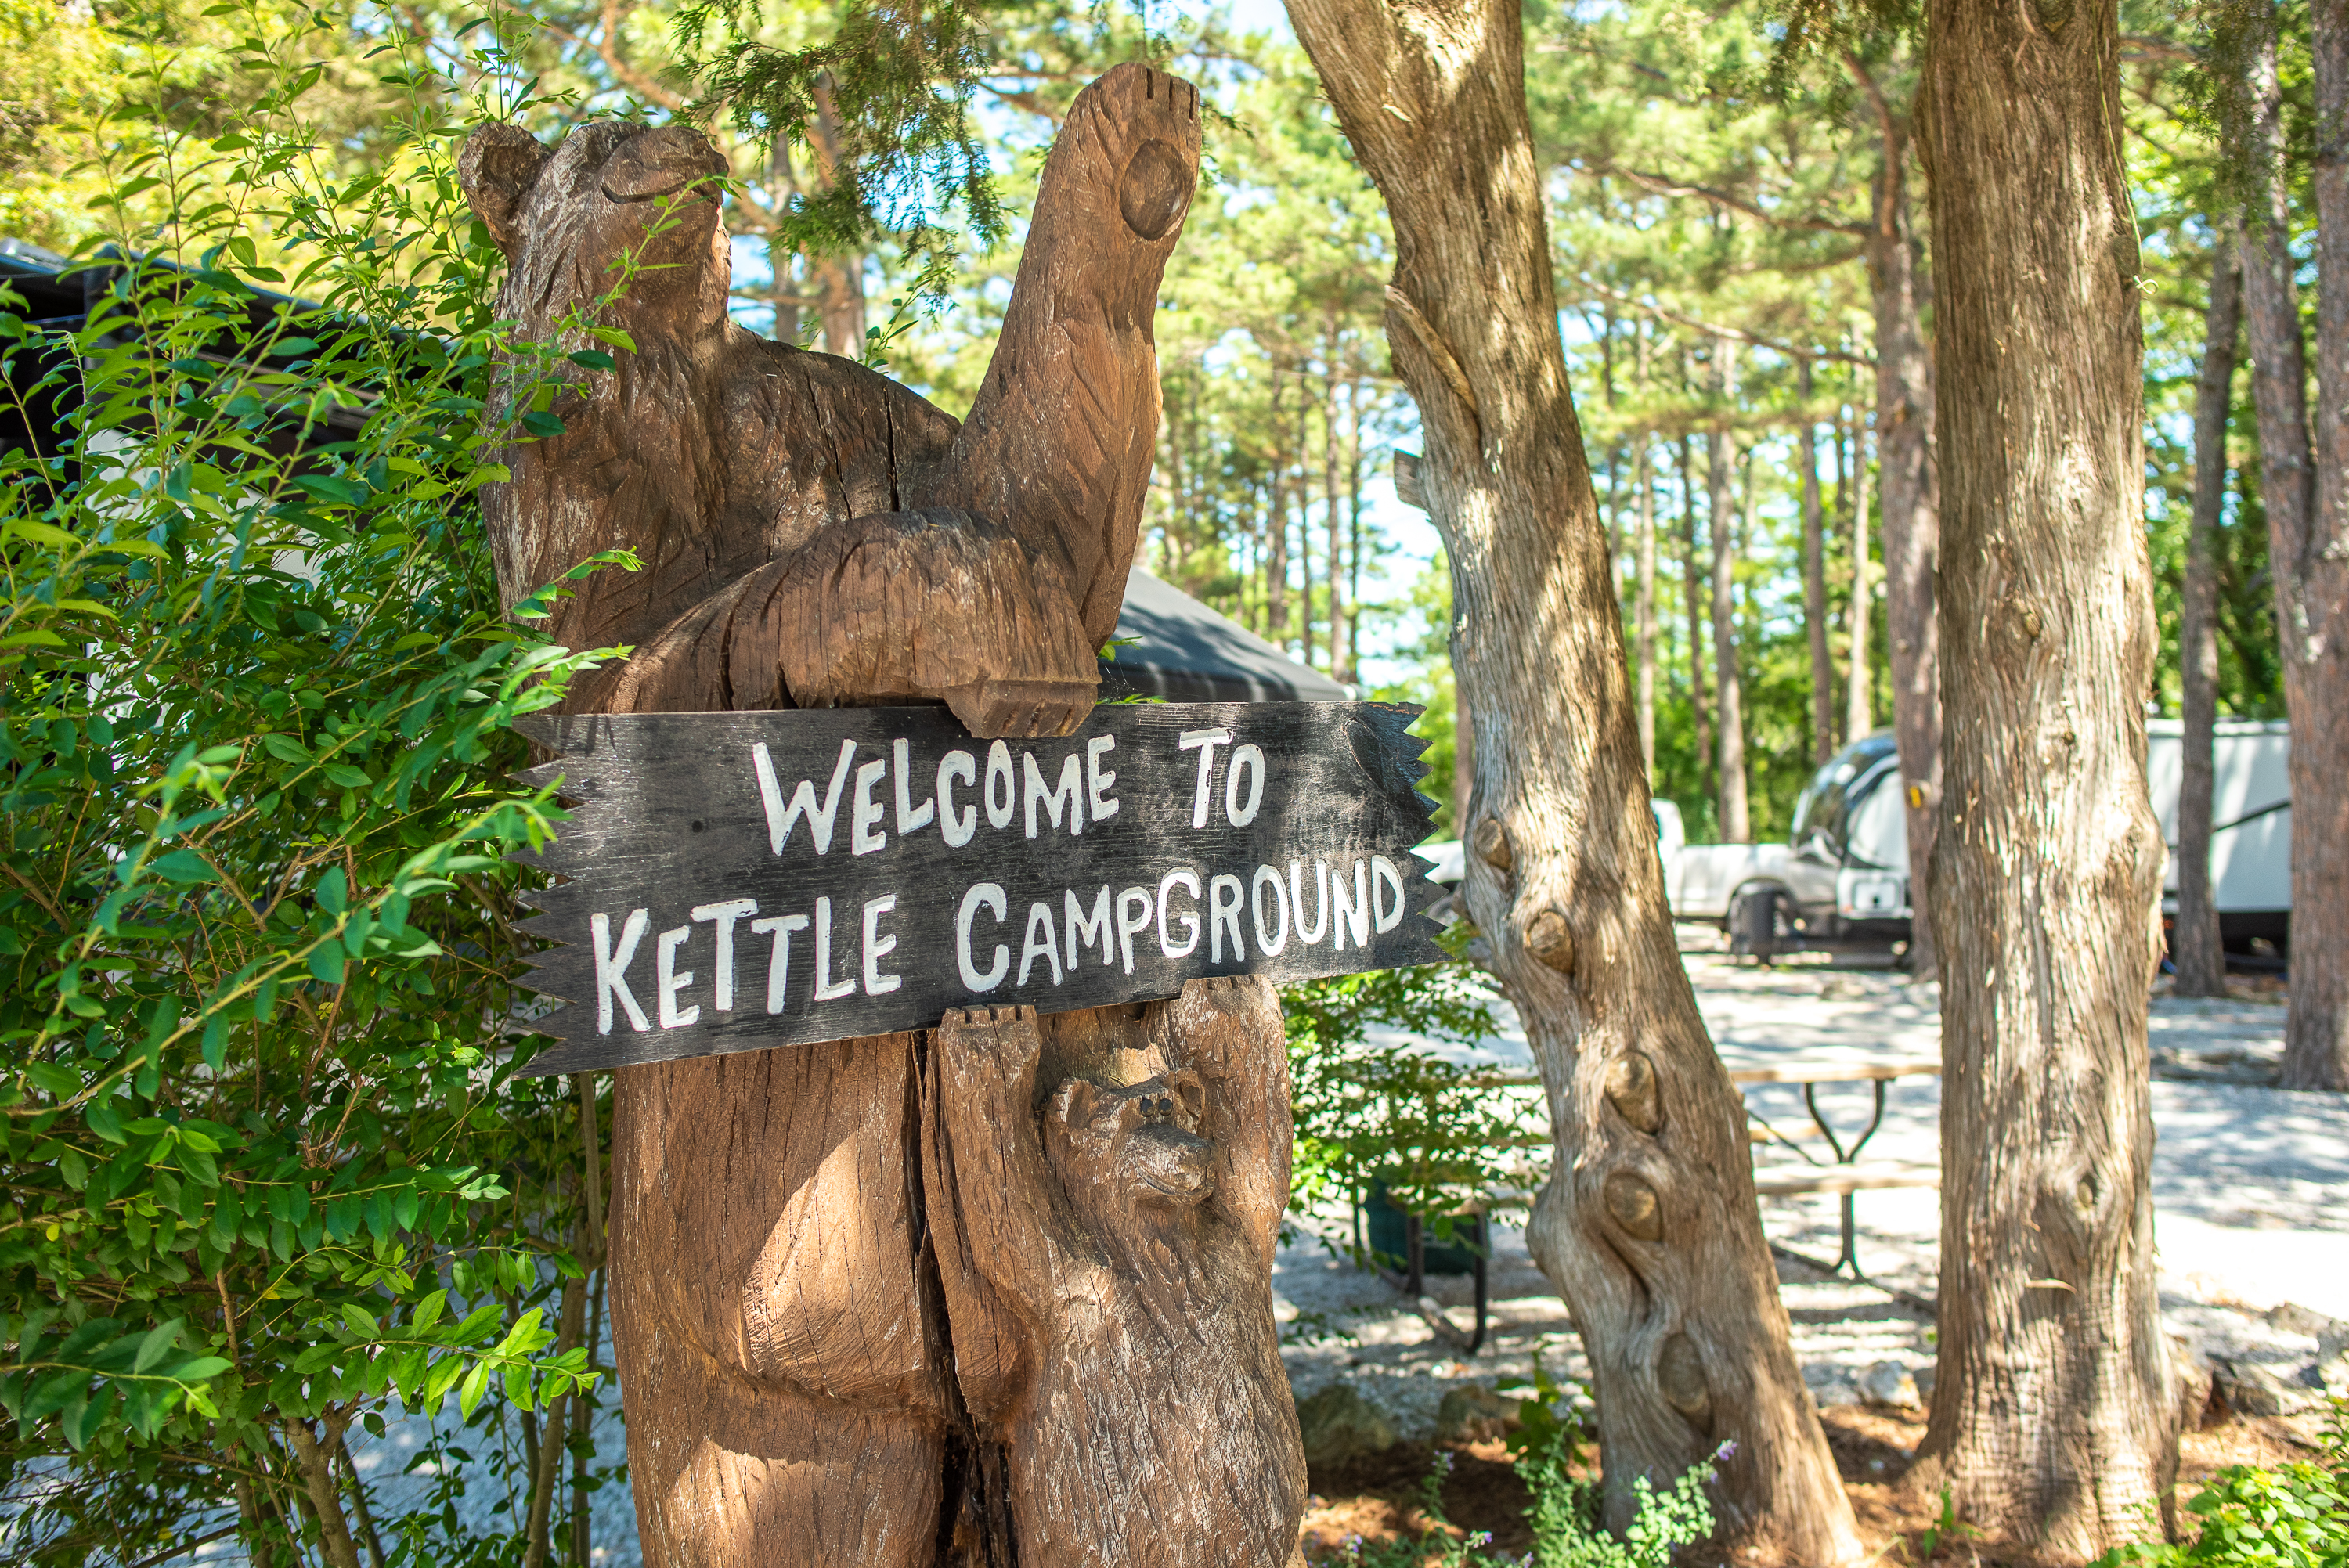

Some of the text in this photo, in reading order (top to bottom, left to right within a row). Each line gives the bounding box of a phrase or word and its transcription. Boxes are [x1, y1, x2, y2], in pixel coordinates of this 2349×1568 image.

[752, 737, 1120, 856] WELCOME
[590, 854, 1405, 1035] KETTLE CAMPGROUND
